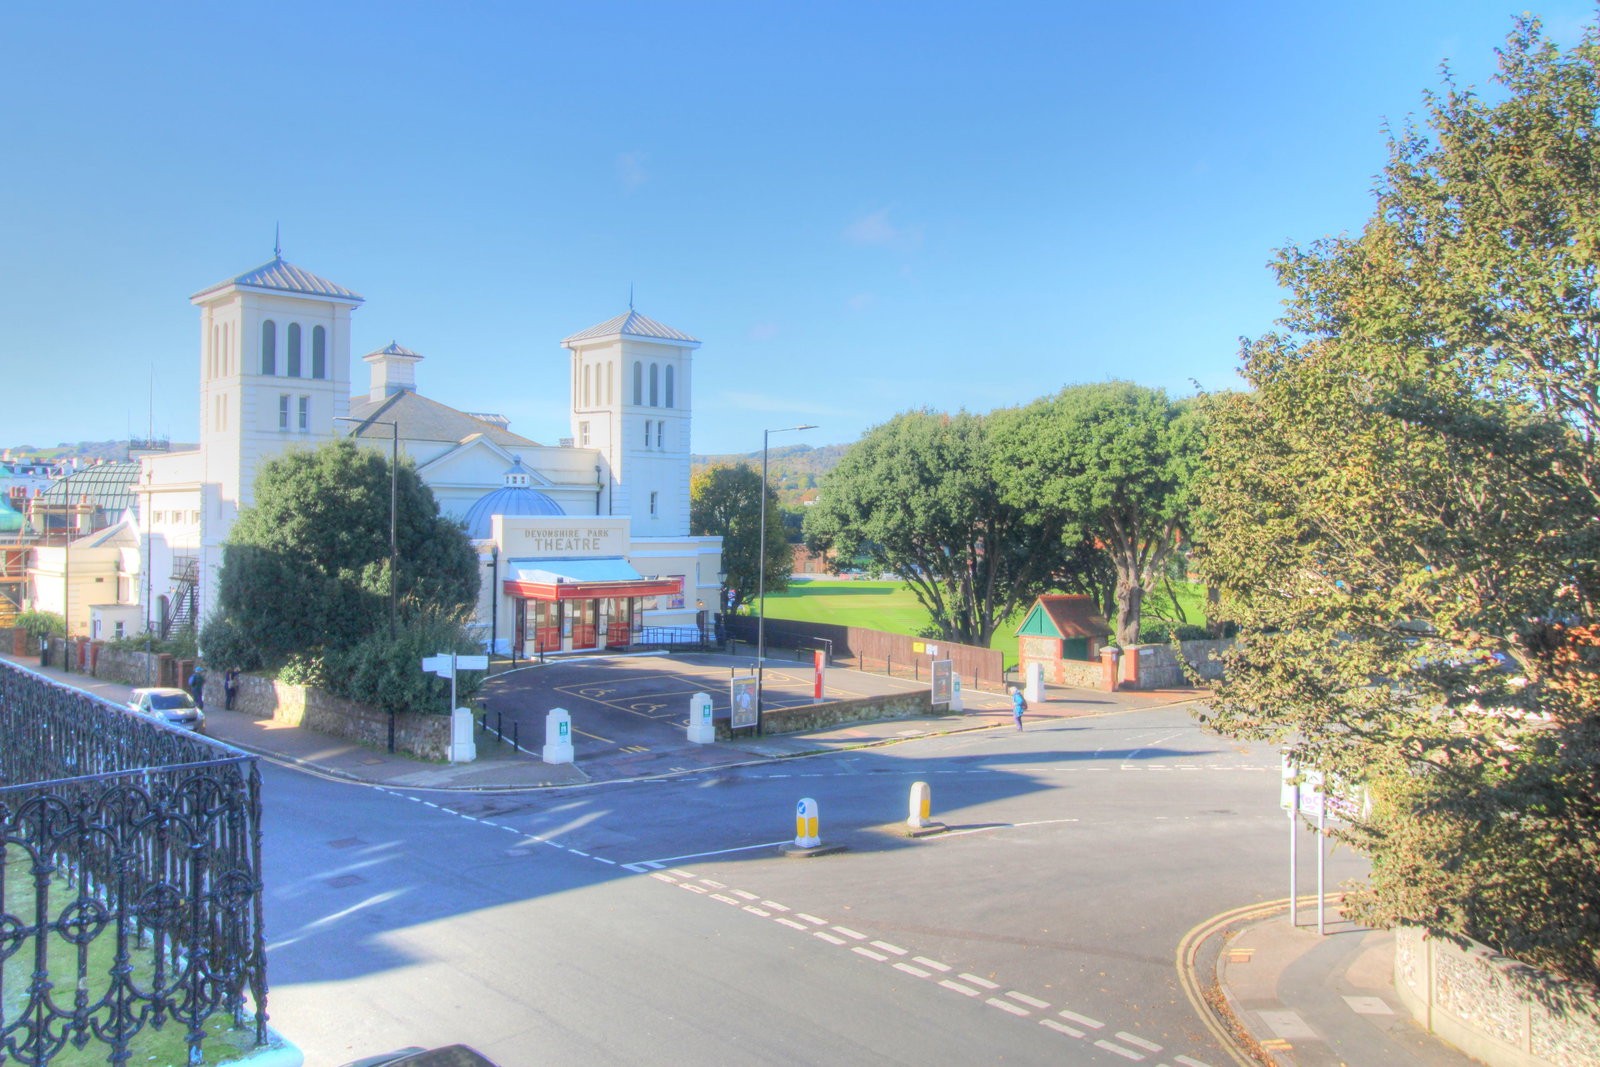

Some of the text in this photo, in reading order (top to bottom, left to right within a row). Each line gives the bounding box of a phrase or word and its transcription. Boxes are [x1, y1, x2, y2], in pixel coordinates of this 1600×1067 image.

[524, 529, 609, 538] DEVONSHIRE PARK
[534, 538, 601, 551] THEATRE
